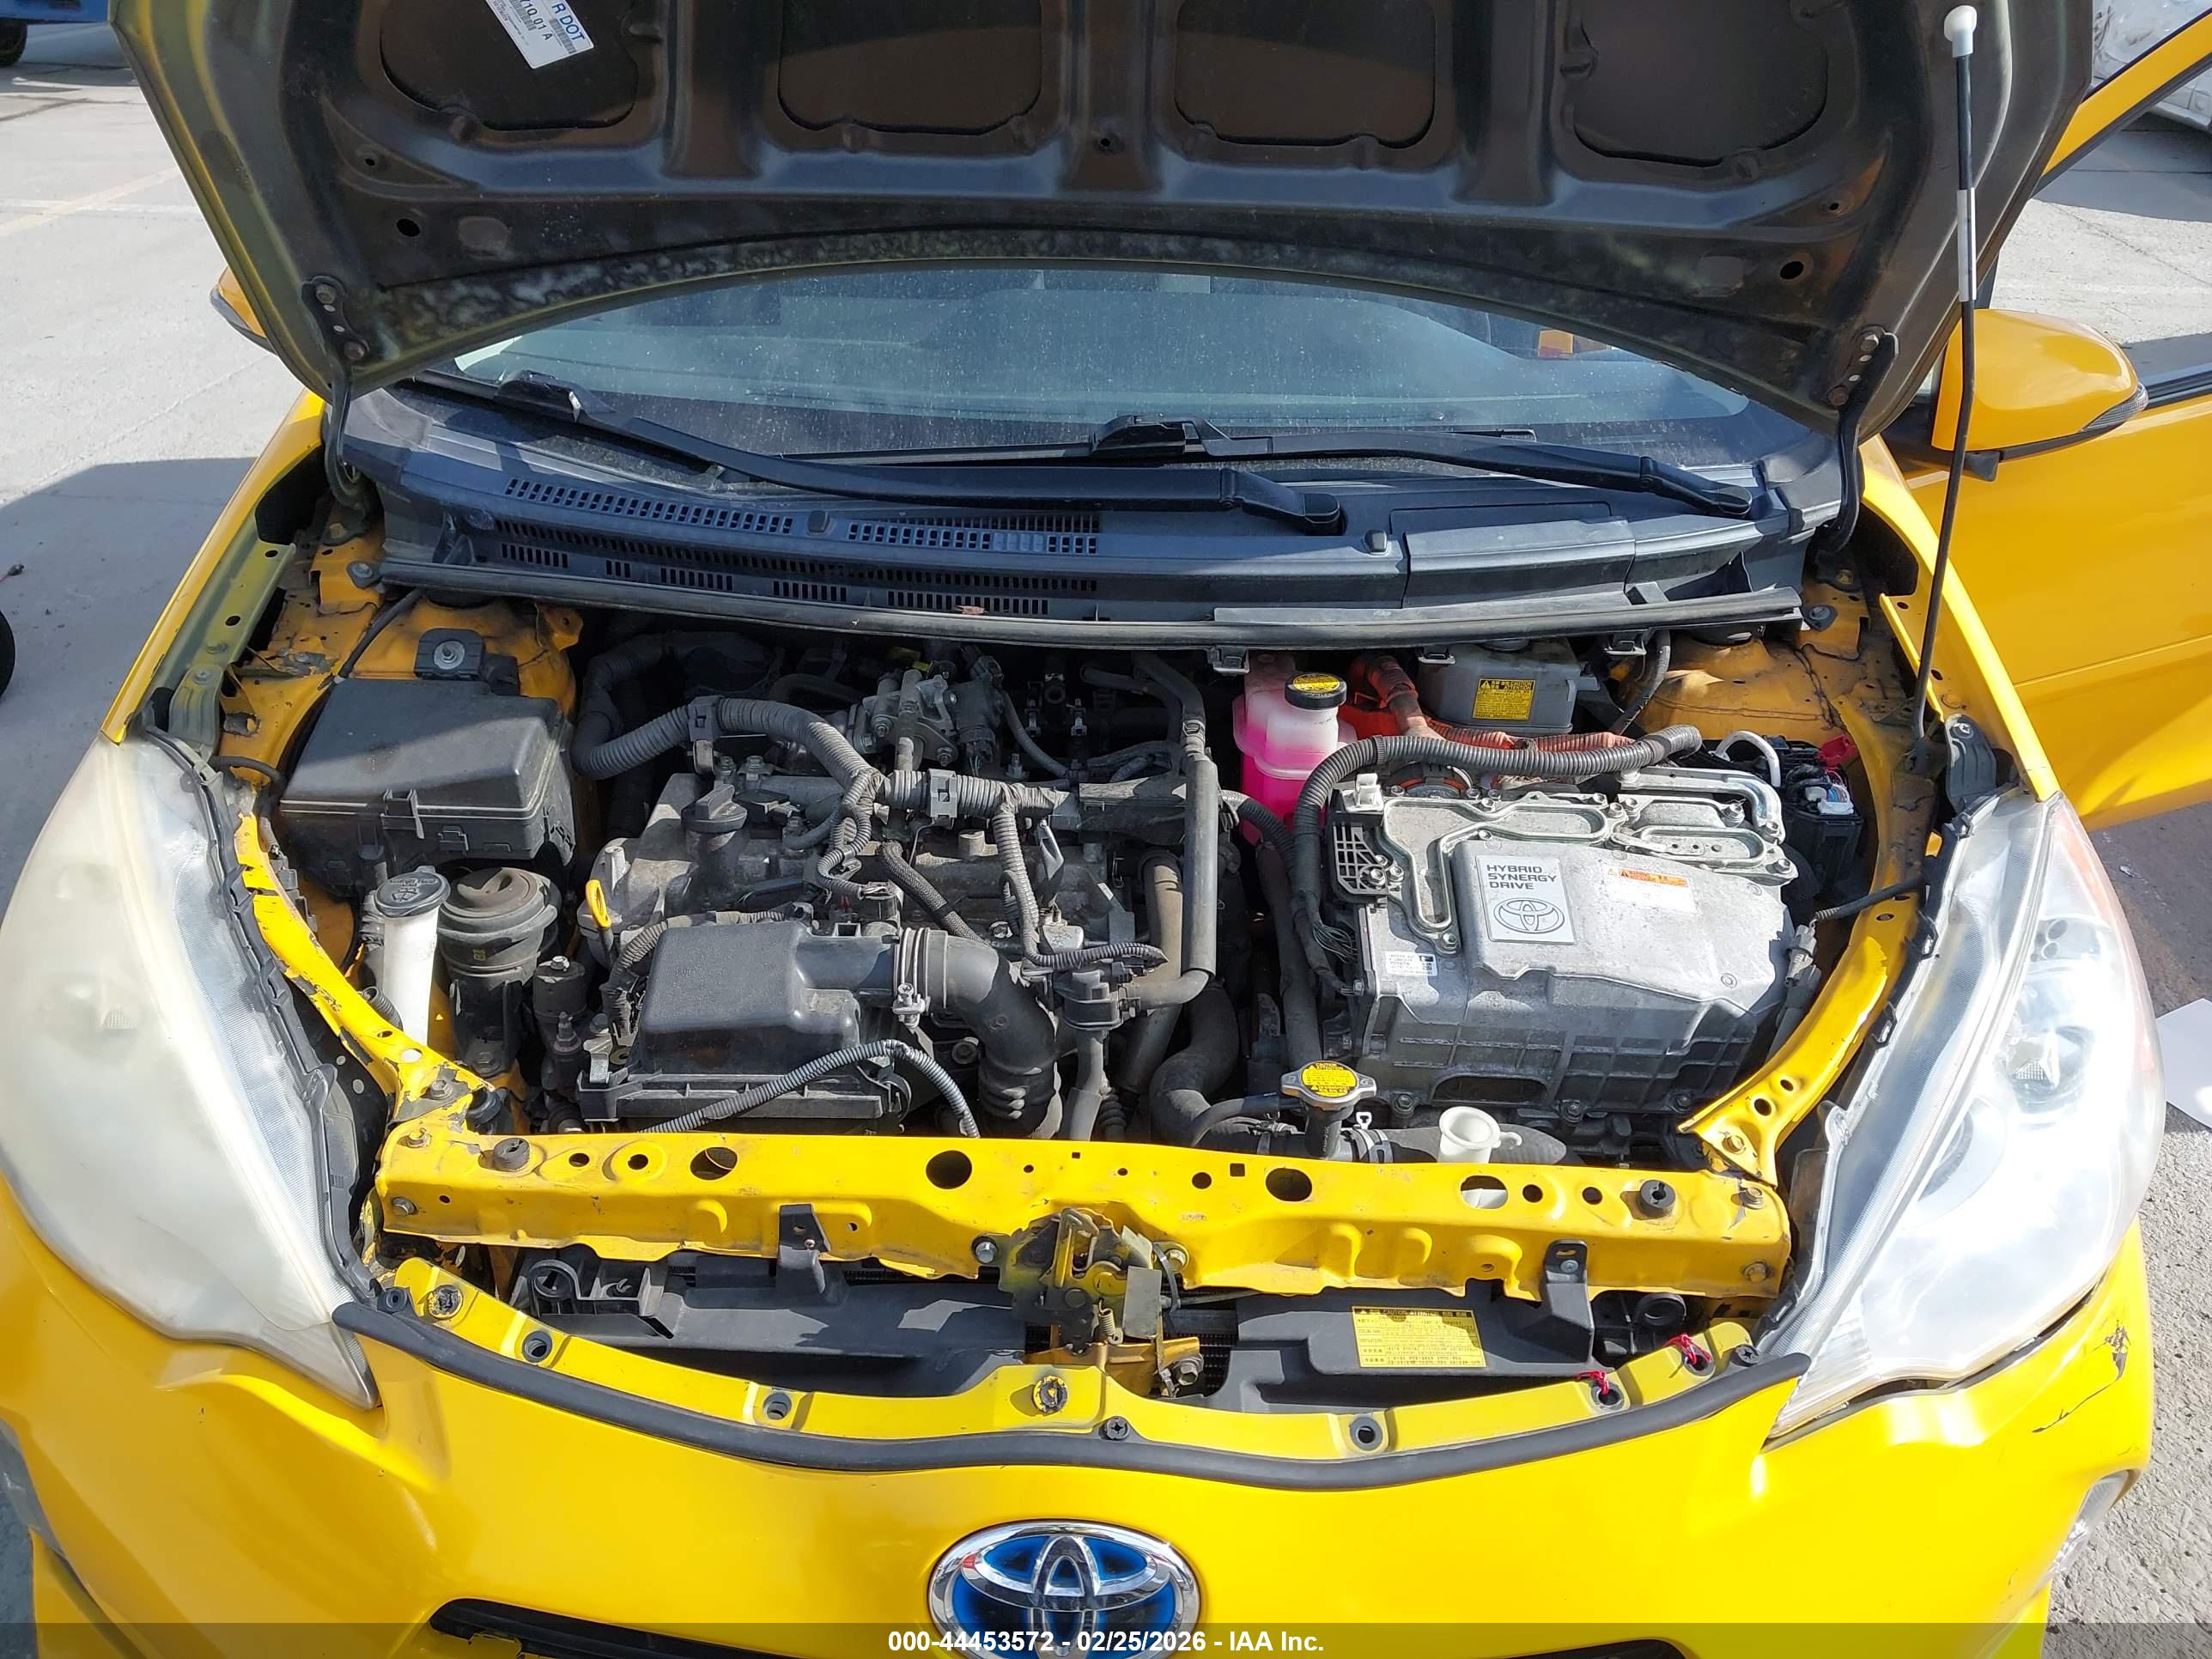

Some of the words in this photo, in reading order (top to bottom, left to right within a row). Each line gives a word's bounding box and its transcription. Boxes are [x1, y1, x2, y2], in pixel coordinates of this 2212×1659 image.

[551, 3, 567, 15] R
[559, 15, 586, 41] DOT
[532, 17, 547, 30] 01
[542, 33, 554, 41] A
[1486, 864, 1542, 874] HYBRID
[1487, 872, 1557, 883] SYNERGY
[1489, 881, 1535, 890] DRIVE
